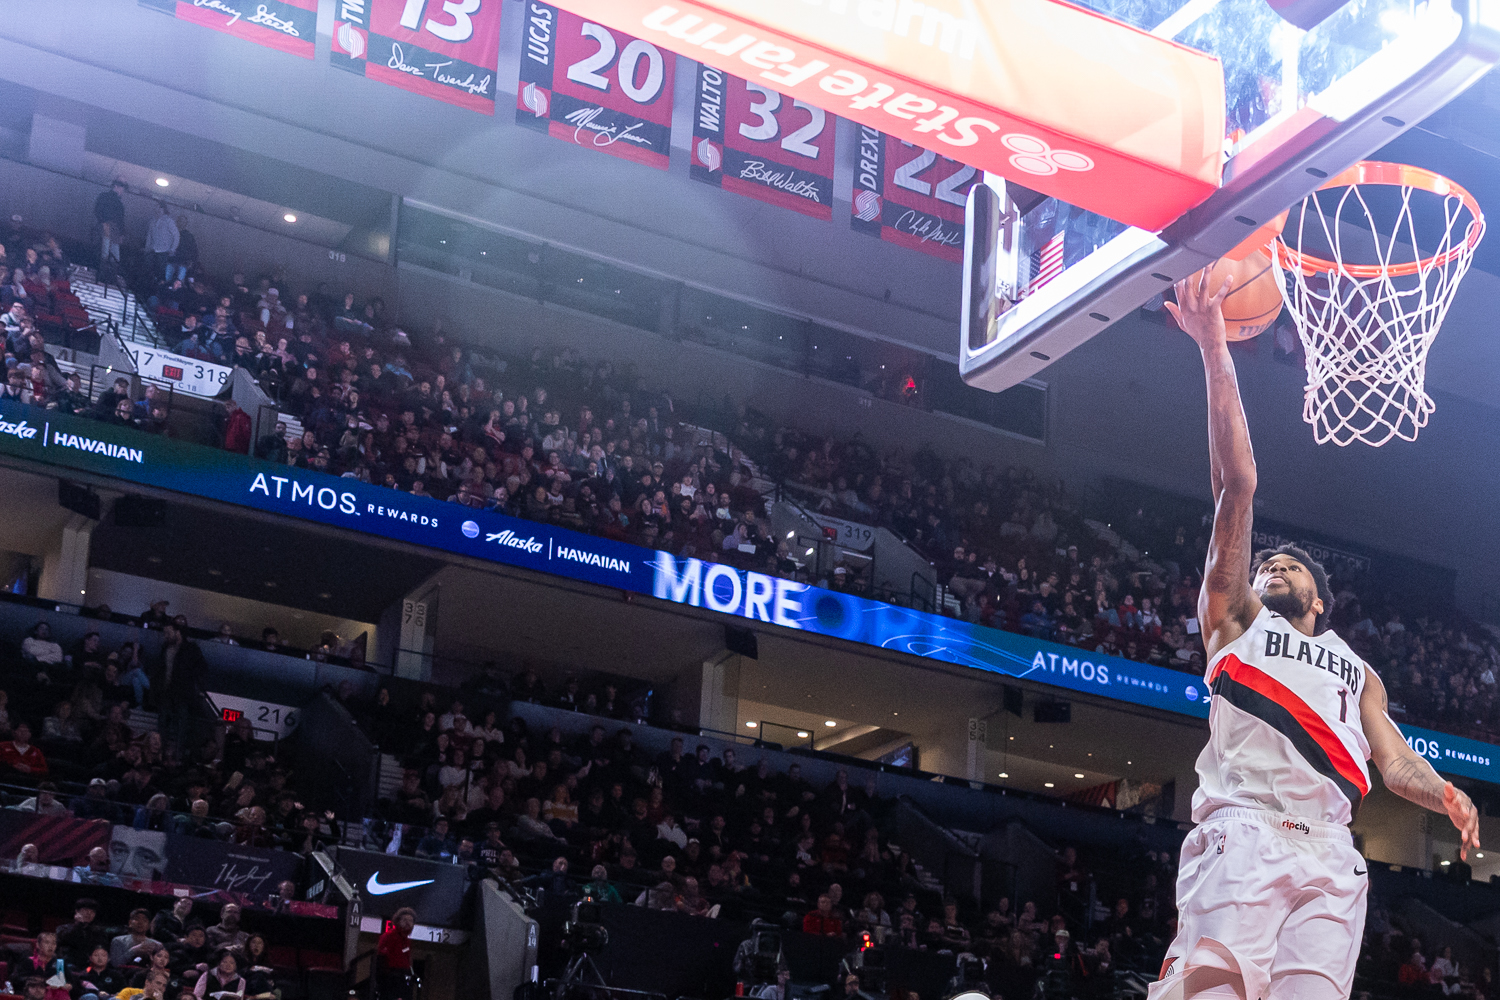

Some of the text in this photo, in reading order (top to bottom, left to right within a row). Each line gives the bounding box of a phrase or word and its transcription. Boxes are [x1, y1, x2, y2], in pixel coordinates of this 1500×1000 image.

[400, 0, 480, 42] 13
[527, 3, 553, 65] LUCAS
[566, 22, 665, 103] 20
[699, 63, 723, 132] WALTO
[738, 80, 826, 159] 32
[893, 140, 977, 207] 22
[194, 365, 228, 385] 318
[53, 431, 143, 464] HAWAIIAN
[249, 473, 439, 528] ATMOS REWARDS
[486, 529, 630, 573] Alaska HAWAIIAN
[845, 526, 872, 542] 319
[653, 550, 803, 629] MORE
[1032, 651, 1169, 694] ATMOS REWARDS
[1264, 630, 1361, 696] BLAZERS
[257, 706, 296, 727] 216
[1337, 688, 1348, 724] 1
[1445, 748, 1490, 766] REWARDS
[1282, 819, 1310, 834] ripcity
